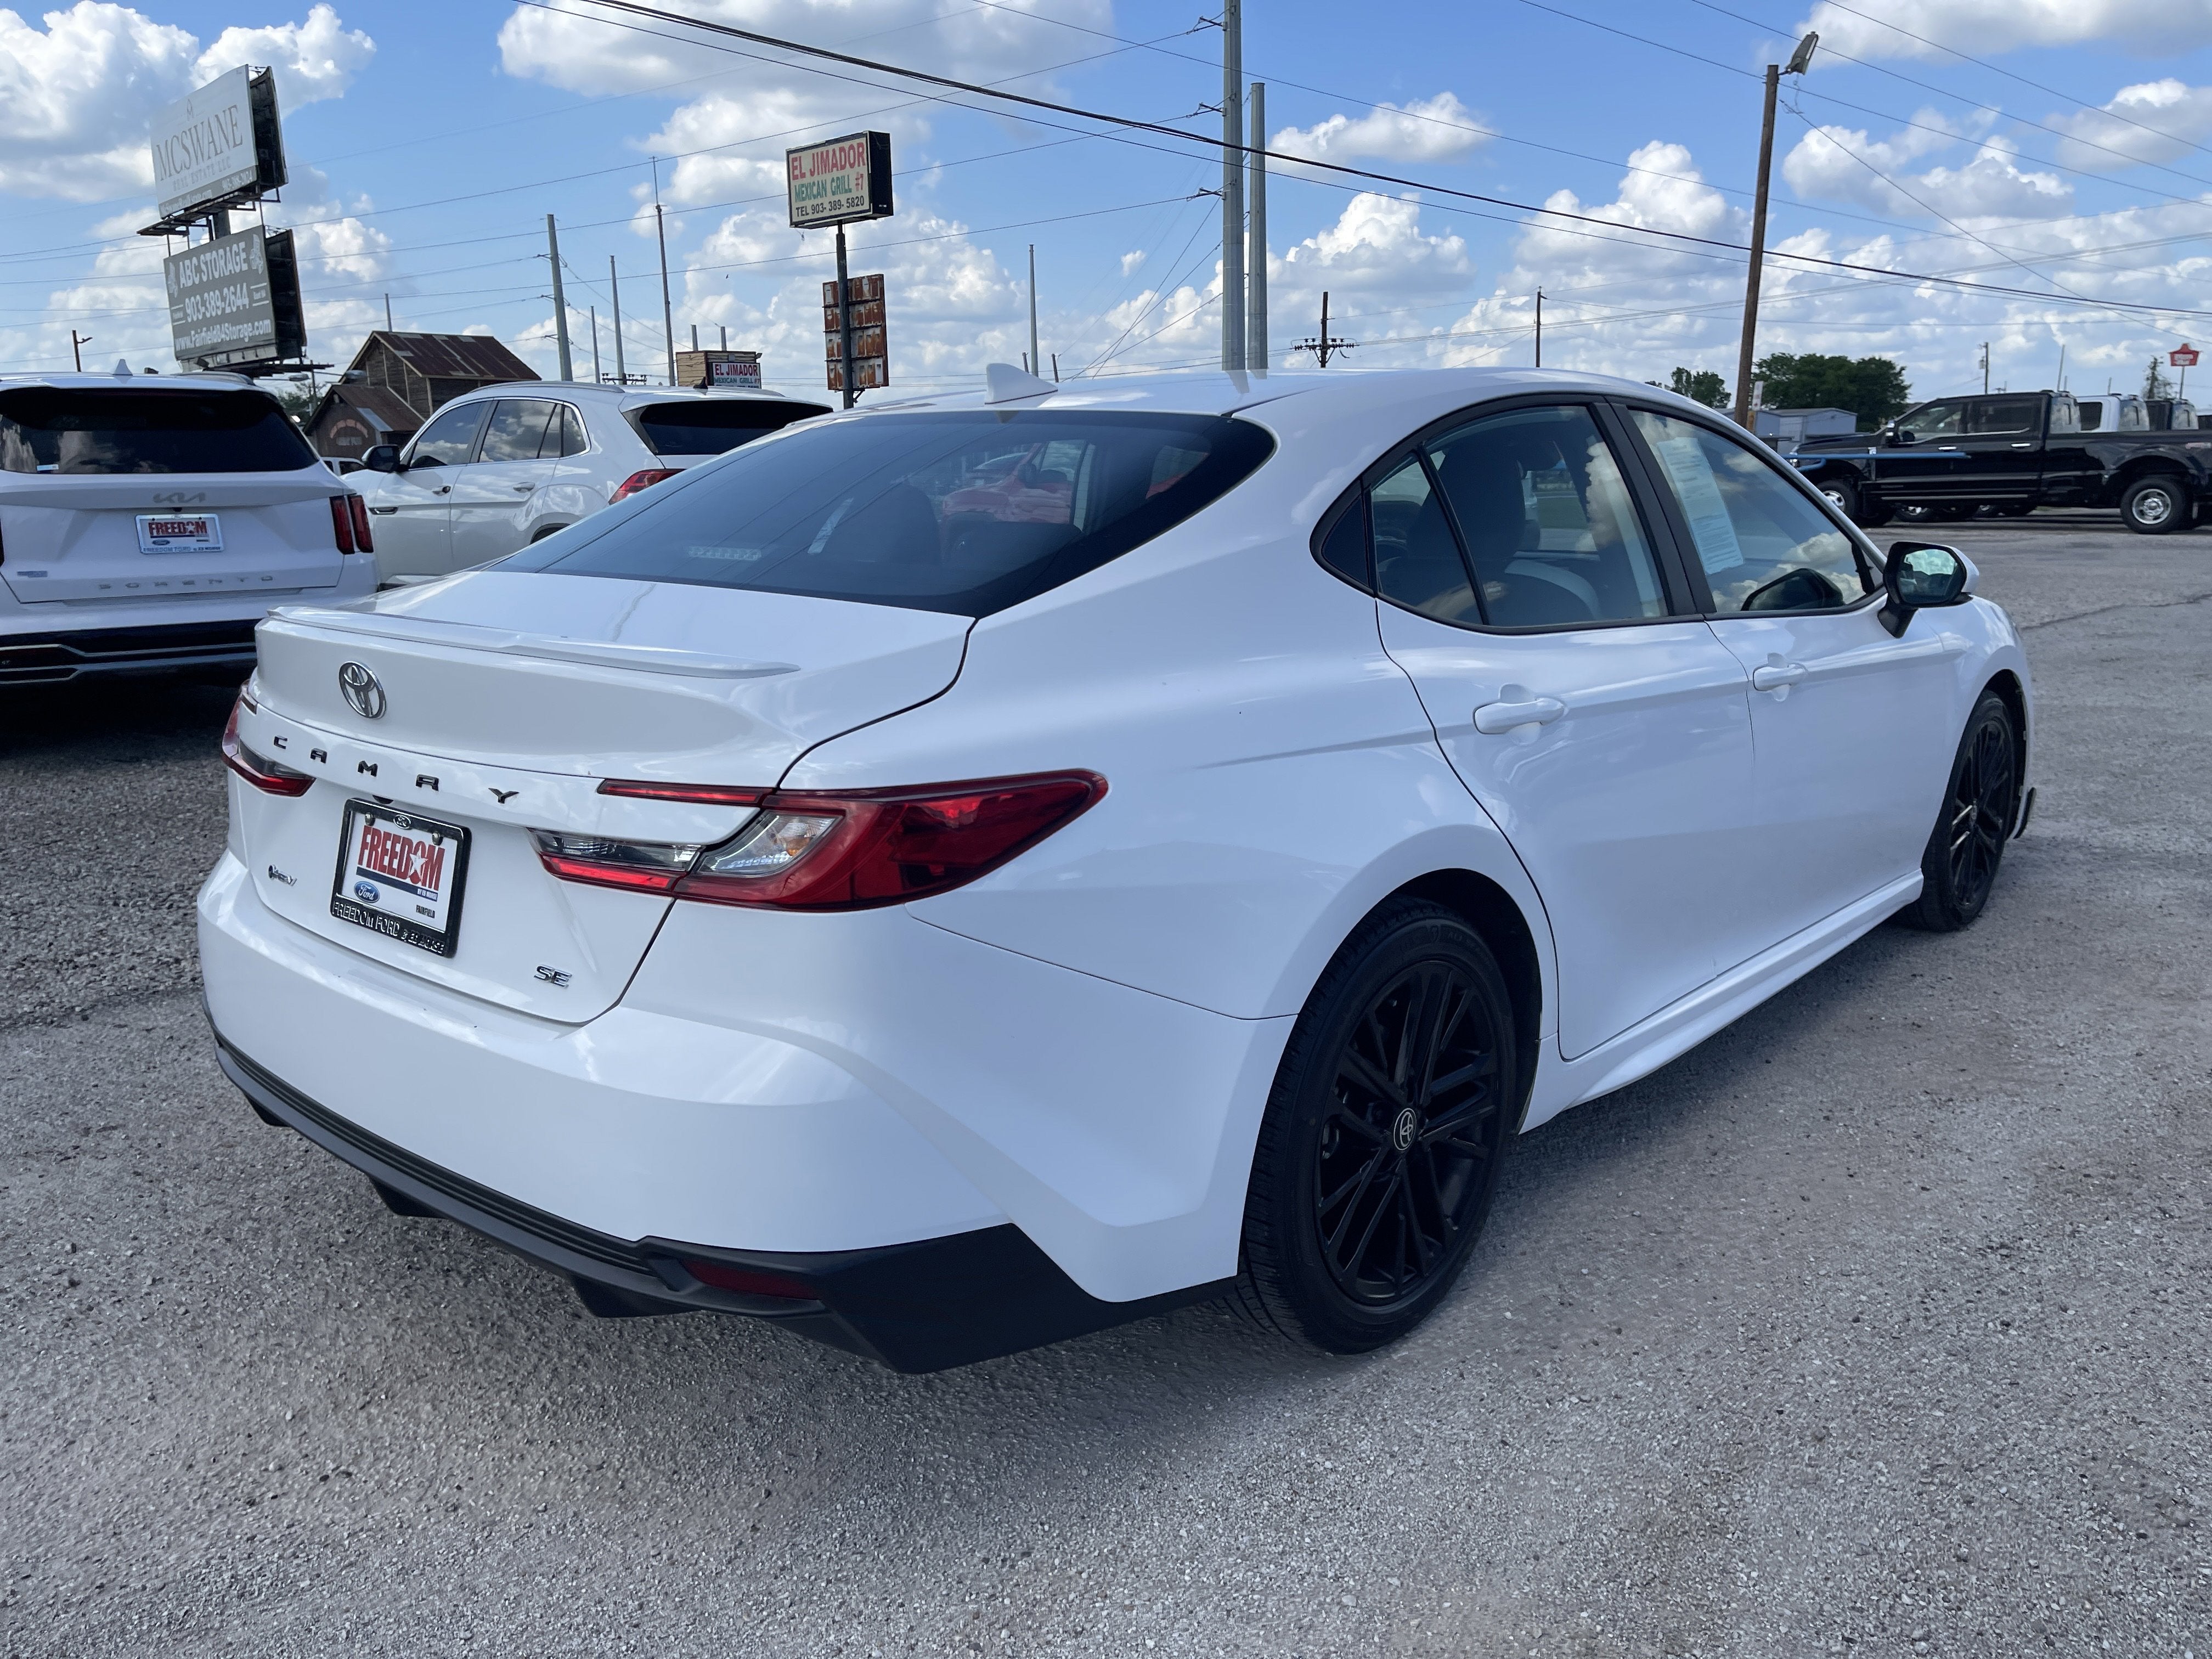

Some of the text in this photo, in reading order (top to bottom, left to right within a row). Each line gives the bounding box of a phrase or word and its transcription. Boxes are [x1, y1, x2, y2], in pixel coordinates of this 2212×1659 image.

[156, 104, 243, 181] MCSWANE
[791, 142, 866, 180] EL JIMADOR
[794, 172, 864, 202] MEXICAN GRILL #7
[796, 206, 809, 217] TEL
[846, 195, 864, 208] 5820
[179, 241, 248, 289] ABC STORAGE
[185, 283, 249, 323] 903-389-2644
[715, 364, 758, 376] EL JIMADOR
[149, 521, 208, 535] FREEDOM
[273, 736, 520, 804] CAMRY
[358, 825, 445, 891] FREEDOM
[332, 902, 374, 928] FREEDOM
[375, 916, 400, 936] FORD
[534, 964, 572, 988] SE
